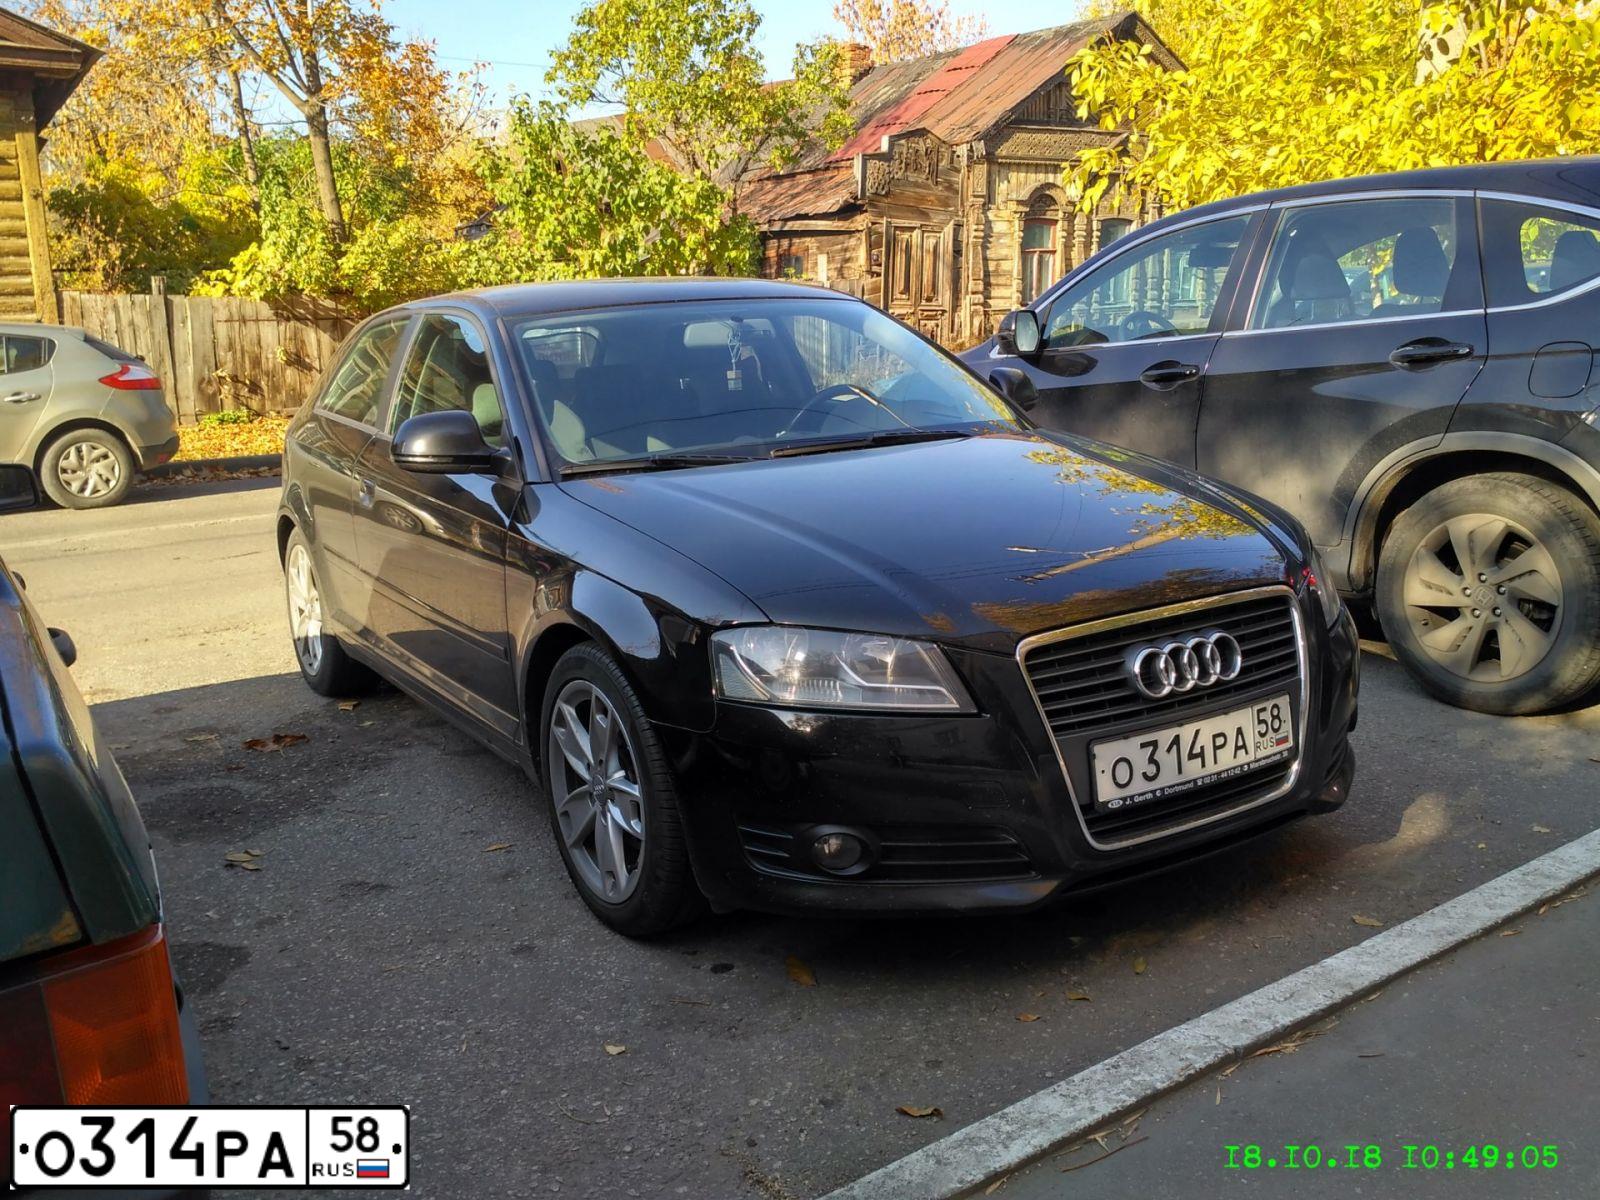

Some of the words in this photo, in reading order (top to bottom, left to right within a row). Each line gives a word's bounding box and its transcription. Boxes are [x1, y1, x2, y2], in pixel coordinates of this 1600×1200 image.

[1256, 703, 1282, 738] 58
[1255, 736, 1275, 752] RUS
[1134, 793, 1153, 803] Gerth
[1164, 782, 1194, 795] Dortmund
